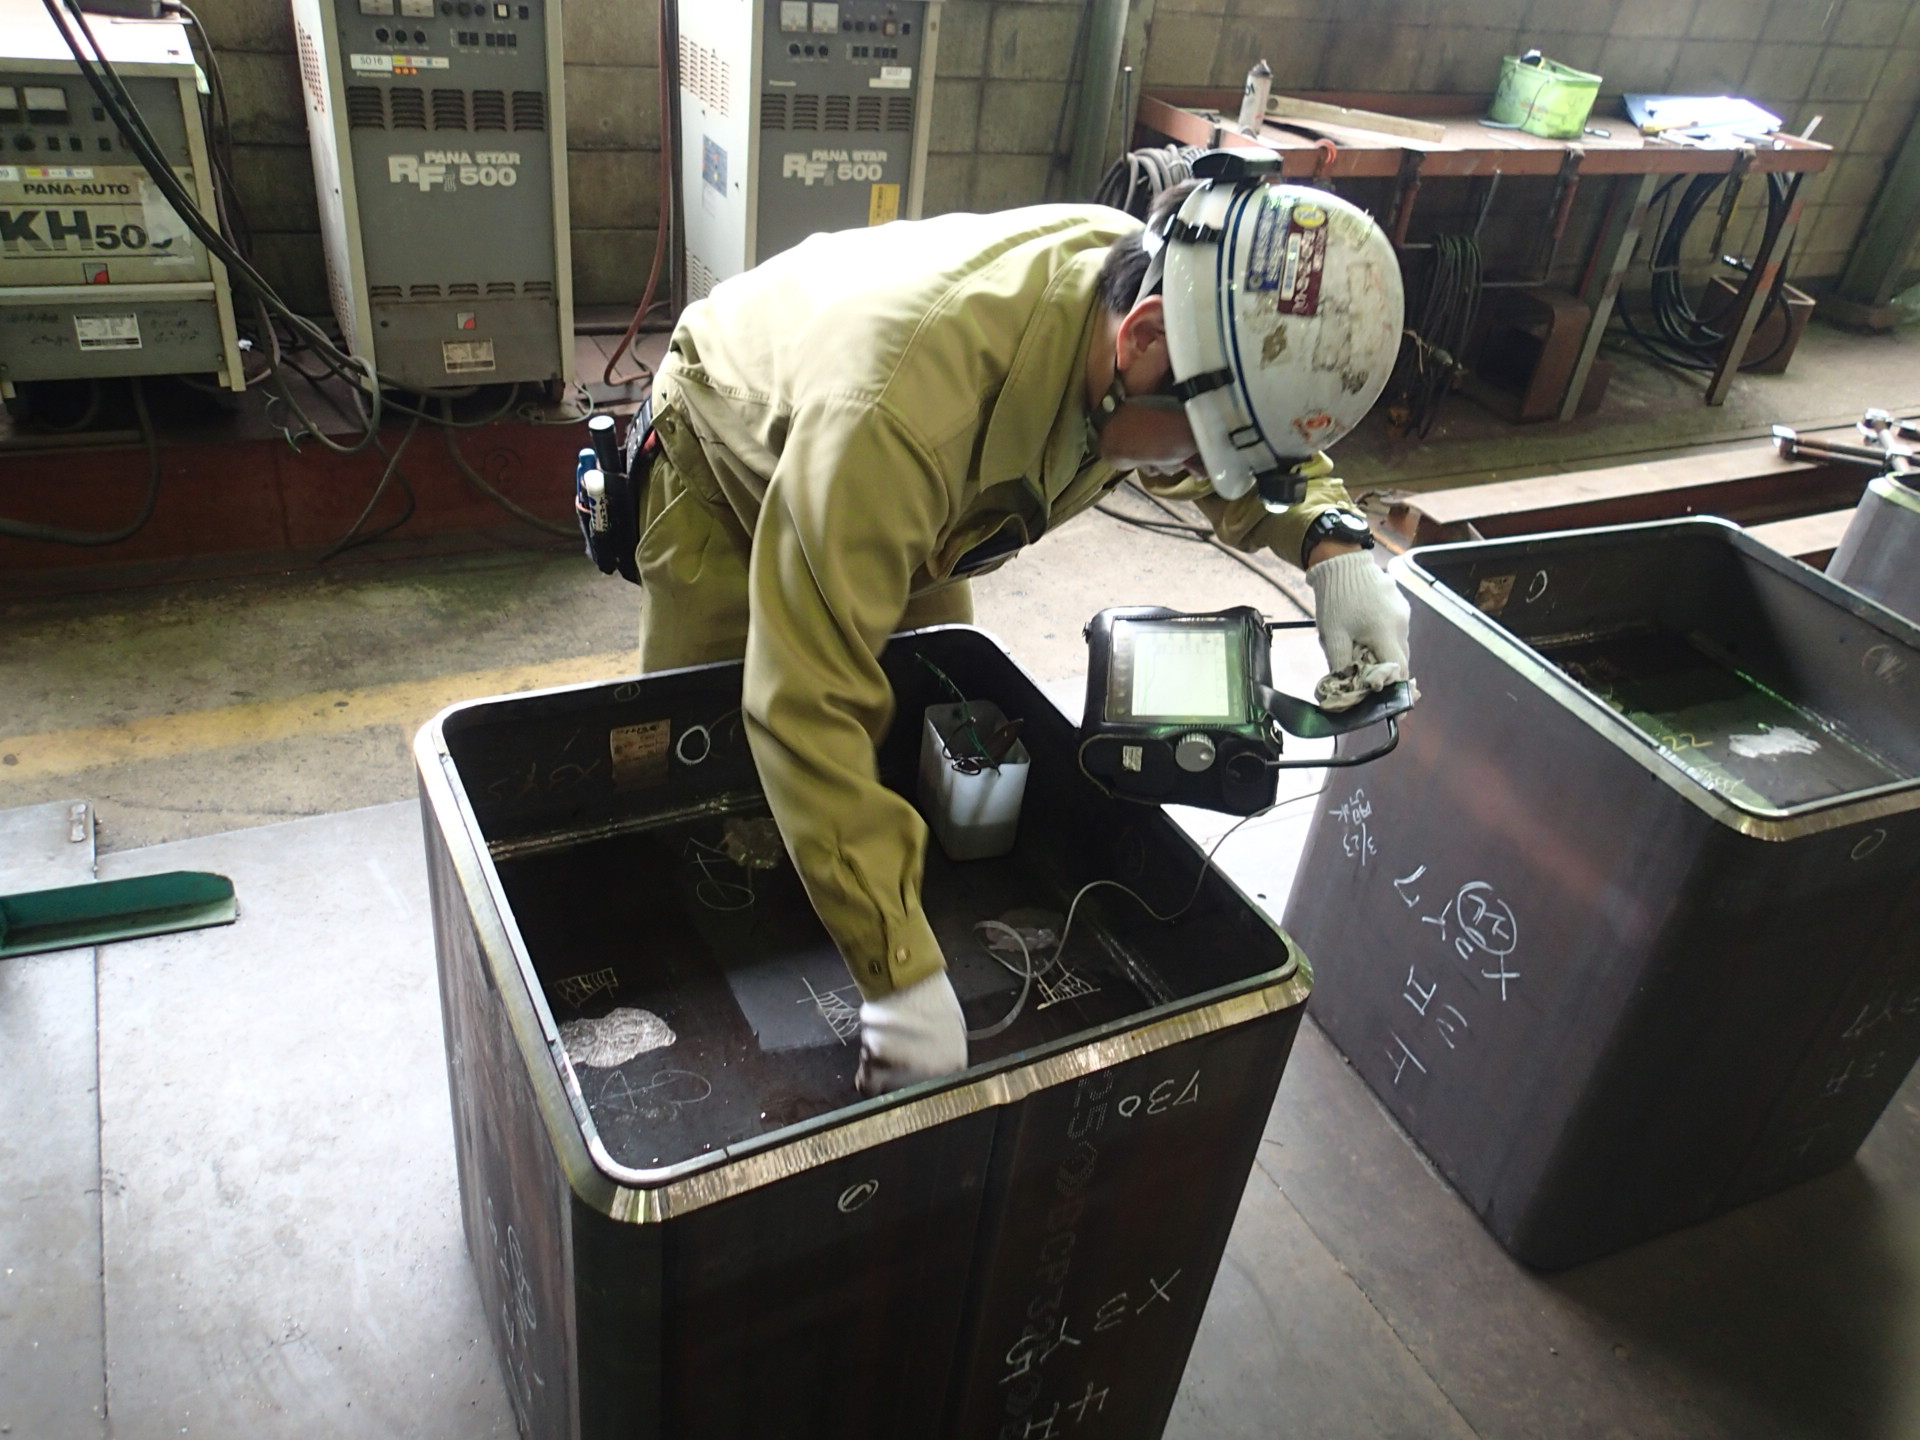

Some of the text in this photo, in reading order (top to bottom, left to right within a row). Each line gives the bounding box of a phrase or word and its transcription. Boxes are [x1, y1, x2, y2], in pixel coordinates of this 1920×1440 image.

[423, 151, 521, 165] PANA STAR
[459, 165, 517, 187] 500
[23, 183, 131, 195] PANA-AUTO
[1118, 1068, 1200, 1118] 730
